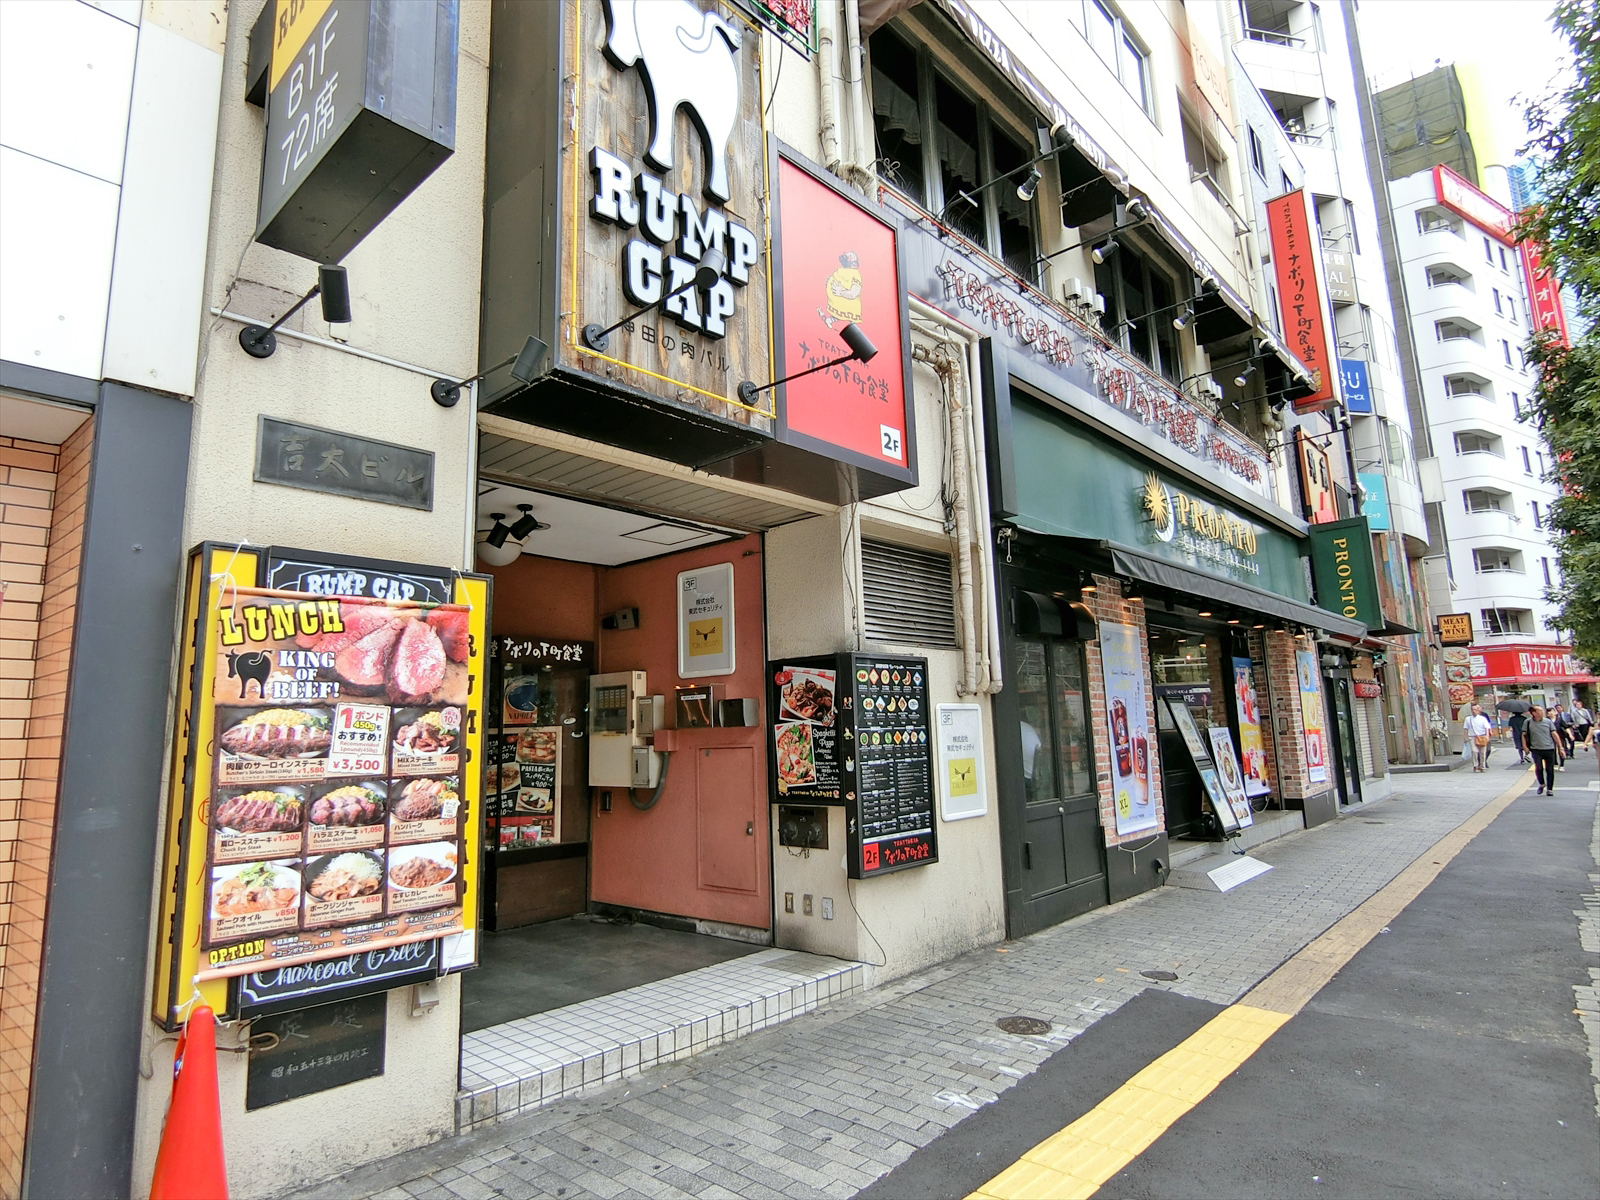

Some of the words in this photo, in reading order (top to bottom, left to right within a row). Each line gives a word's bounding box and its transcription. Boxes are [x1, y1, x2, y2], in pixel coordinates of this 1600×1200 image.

[288, 10, 338, 120] B1F
[282, 71, 338, 186] 72席
[589, 145, 758, 286] RUMP
[1283, 202, 1295, 250] TRATTORIA
[622, 238, 735, 340] CAP
[1288, 253, 1316, 363] ナポリの下町食堂
[799, 340, 889, 404] ナポリの下町食堂
[883, 432, 899, 452] 2F
[270, 431, 424, 485] 吉大ビル
[1177, 491, 1258, 556] PRONTO
[685, 580, 695, 589] 3F
[1333, 537, 1358, 619] PRONTO
[307, 574, 367, 598] RUMP
[372, 577, 416, 601] CAP
[219, 599, 345, 646] LUNCH
[1443, 617, 1465, 625] MEAT
[503, 636, 584, 662] ナポリの下町食堂
[277, 649, 336, 669] KING
[295, 667, 318, 682] OF
[272, 680, 341, 700] BEEF!
[942, 714, 951, 724] 3F
[338, 731, 382, 742] おすすめ!
[812, 728, 836, 739] Spaghetti
[340, 740, 380, 748] Recommended
[818, 738, 835, 749] Pizza
[225, 760, 325, 771] 肉屋のサーロインステーキ
[297, 766, 325, 774] ¥1,580
[333, 759, 380, 771] ¥3,500
[1119, 799, 1129, 813] XL
[360, 825, 383, 834] ¥1,050
[394, 822, 423, 831] ハンバーグ
[273, 833, 300, 842] ¥1,200
[313, 829, 359, 839] ハラミステーキ
[865, 849, 878, 865] 2F
[884, 842, 929, 865] ナポリの下町食堂
[392, 890, 428, 900] 牛すじカレー
[437, 884, 454, 892] ¥850
[310, 900, 360, 912] ポークジンジャー
[361, 895, 381, 904] ¥850
[275, 908, 297, 917] ¥850
[216, 914, 262, 926] ポークオイル
[209, 939, 265, 965] OPTION
[252, 952, 361, 988] Charcoal
